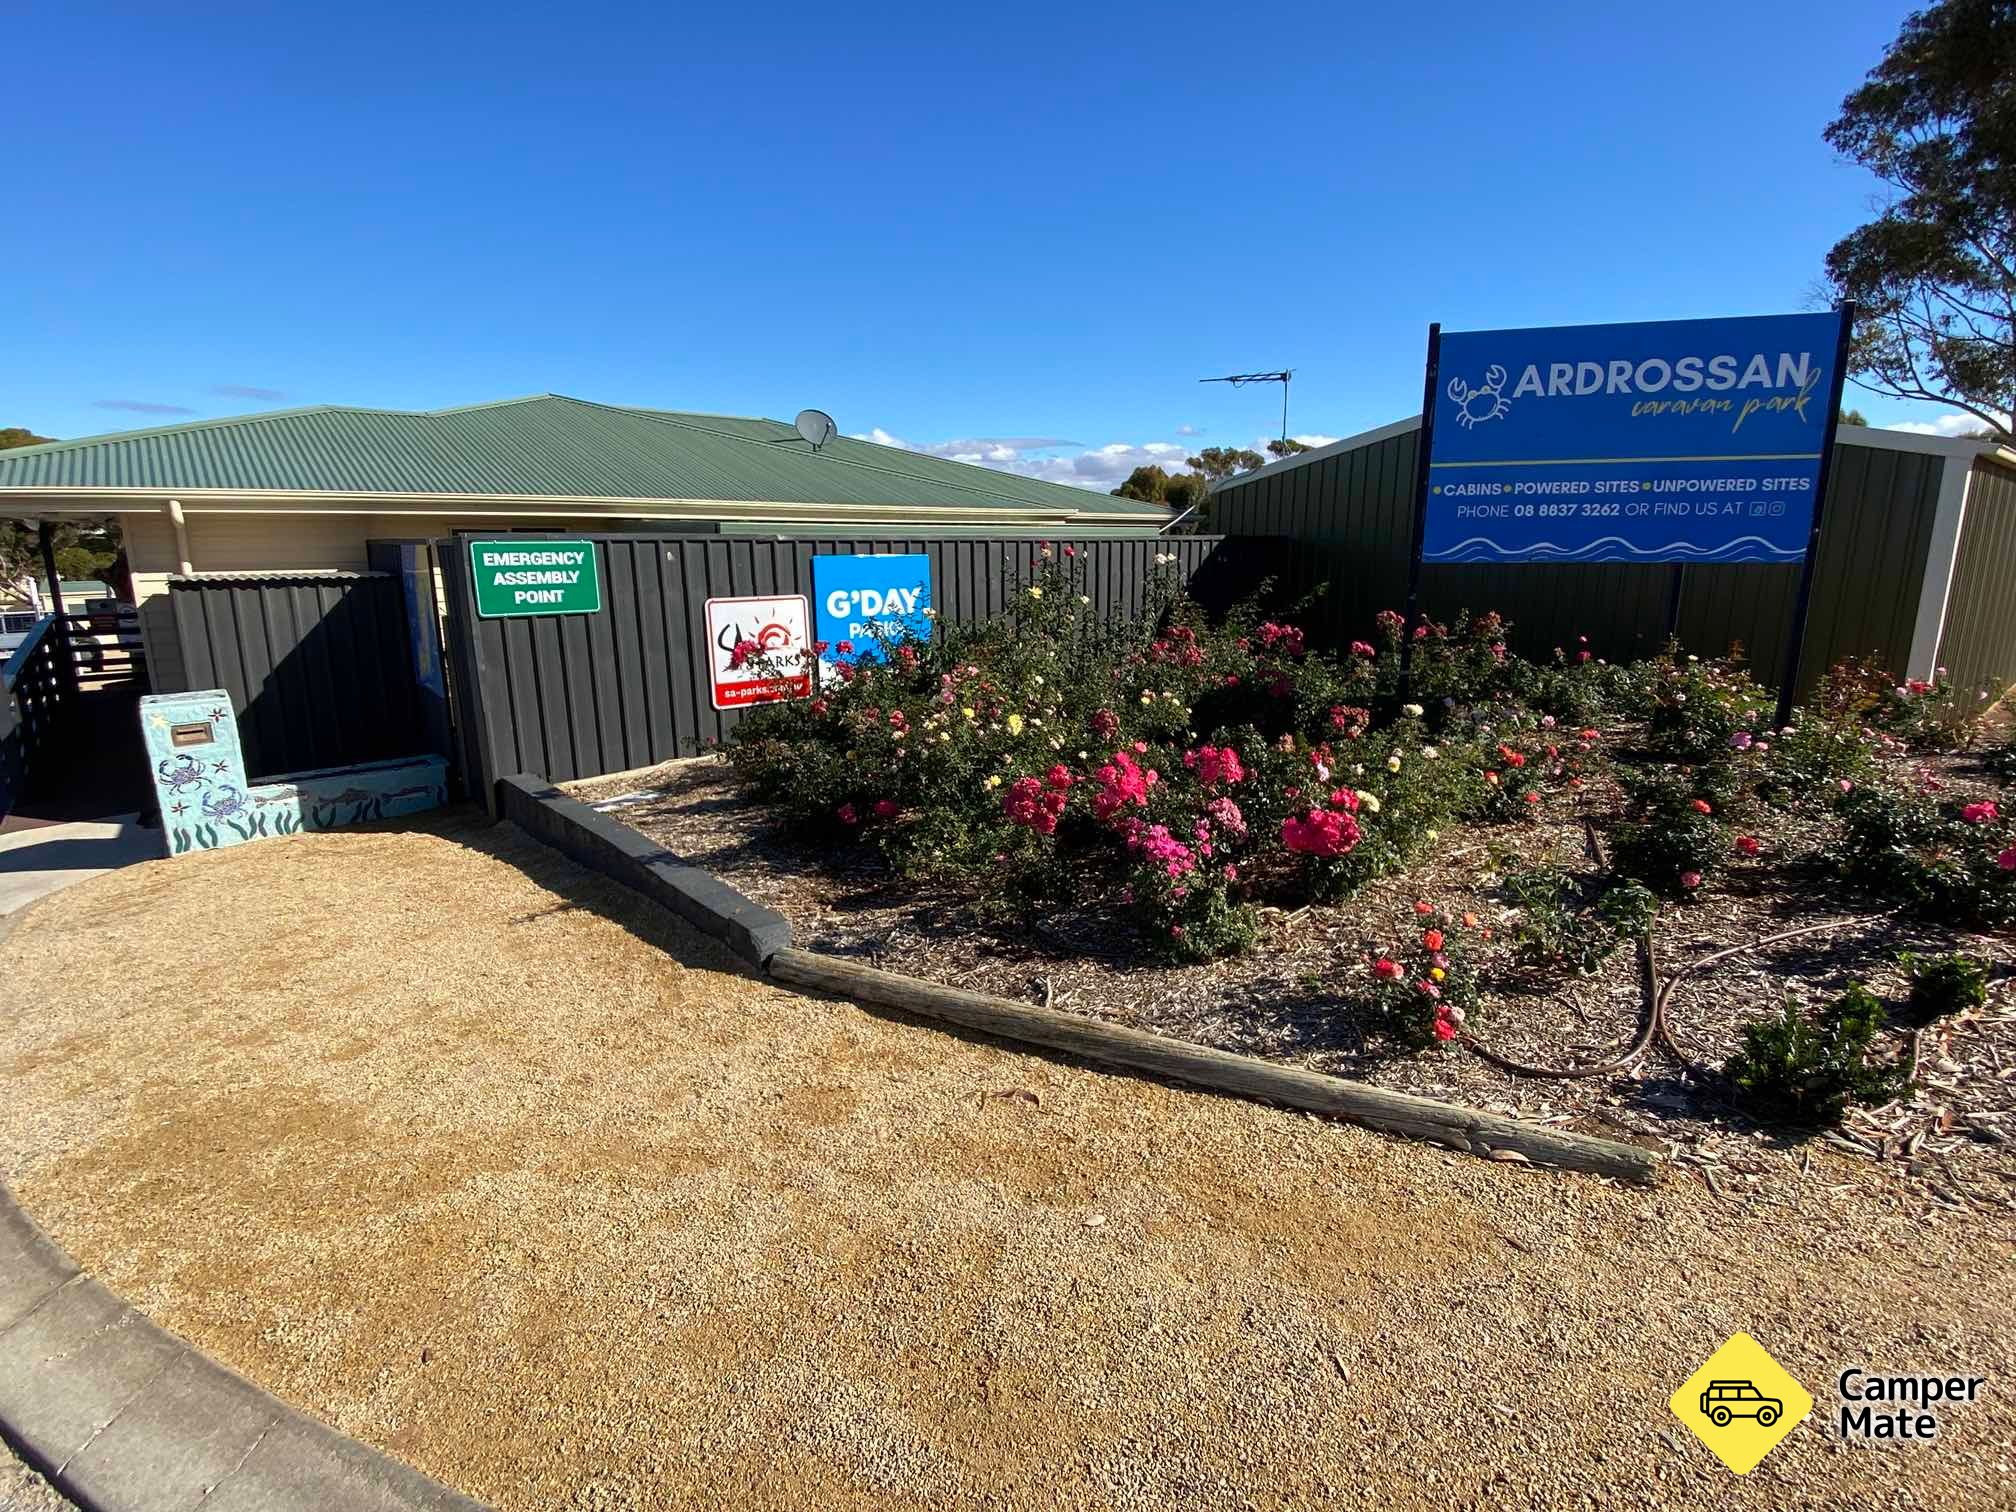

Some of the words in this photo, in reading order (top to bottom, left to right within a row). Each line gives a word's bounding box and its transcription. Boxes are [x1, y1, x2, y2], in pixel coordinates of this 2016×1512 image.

[1513, 352, 1810, 398] ARDROSSAN
[1631, 398, 1735, 417] caravan
[1731, 367, 1822, 435] park
[1443, 483, 1502, 497] CABINS
[1513, 481, 1590, 495] POWERED
[1594, 480, 1640, 494] SITES
[1652, 478, 1757, 493] UNPOWERED
[1762, 477, 1811, 492] SITES
[1457, 504, 1510, 518] PHONE
[1513, 504, 1535, 517] 08
[1538, 503, 1578, 517] 8837
[1581, 503, 1620, 516] 3262
[1624, 502, 1650, 516] OR
[1654, 502, 1690, 516] FIND
[1695, 501, 1718, 516] US
[1721, 501, 1744, 515] AT
[482, 551, 585, 567] EMERGENCY
[493, 570, 580, 586] ASSEMBLY
[514, 589, 565, 605] POINT
[757, 653, 801, 670] ARKS
